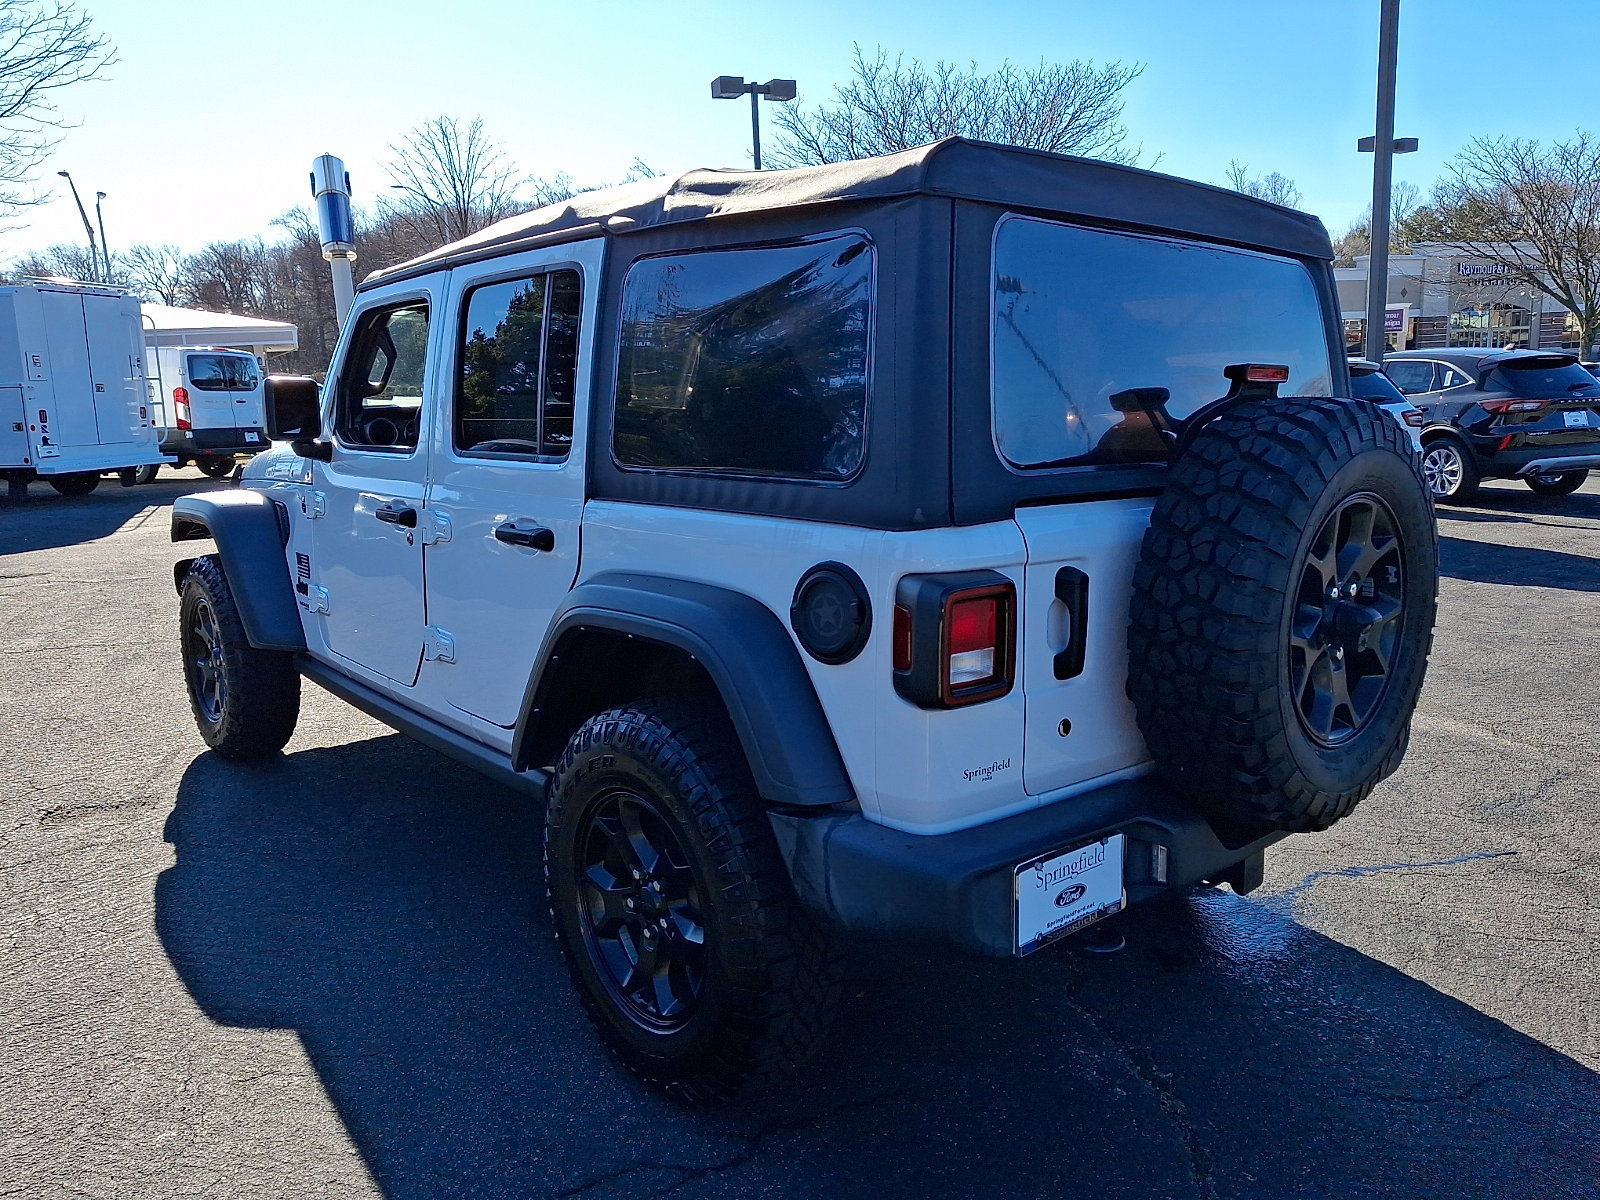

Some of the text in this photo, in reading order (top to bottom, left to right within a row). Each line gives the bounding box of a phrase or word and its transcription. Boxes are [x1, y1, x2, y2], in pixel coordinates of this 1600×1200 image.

[962, 757, 1011, 781] Springfield
[1035, 844, 1106, 891] Springfield
[1059, 886, 1083, 906] Ford
